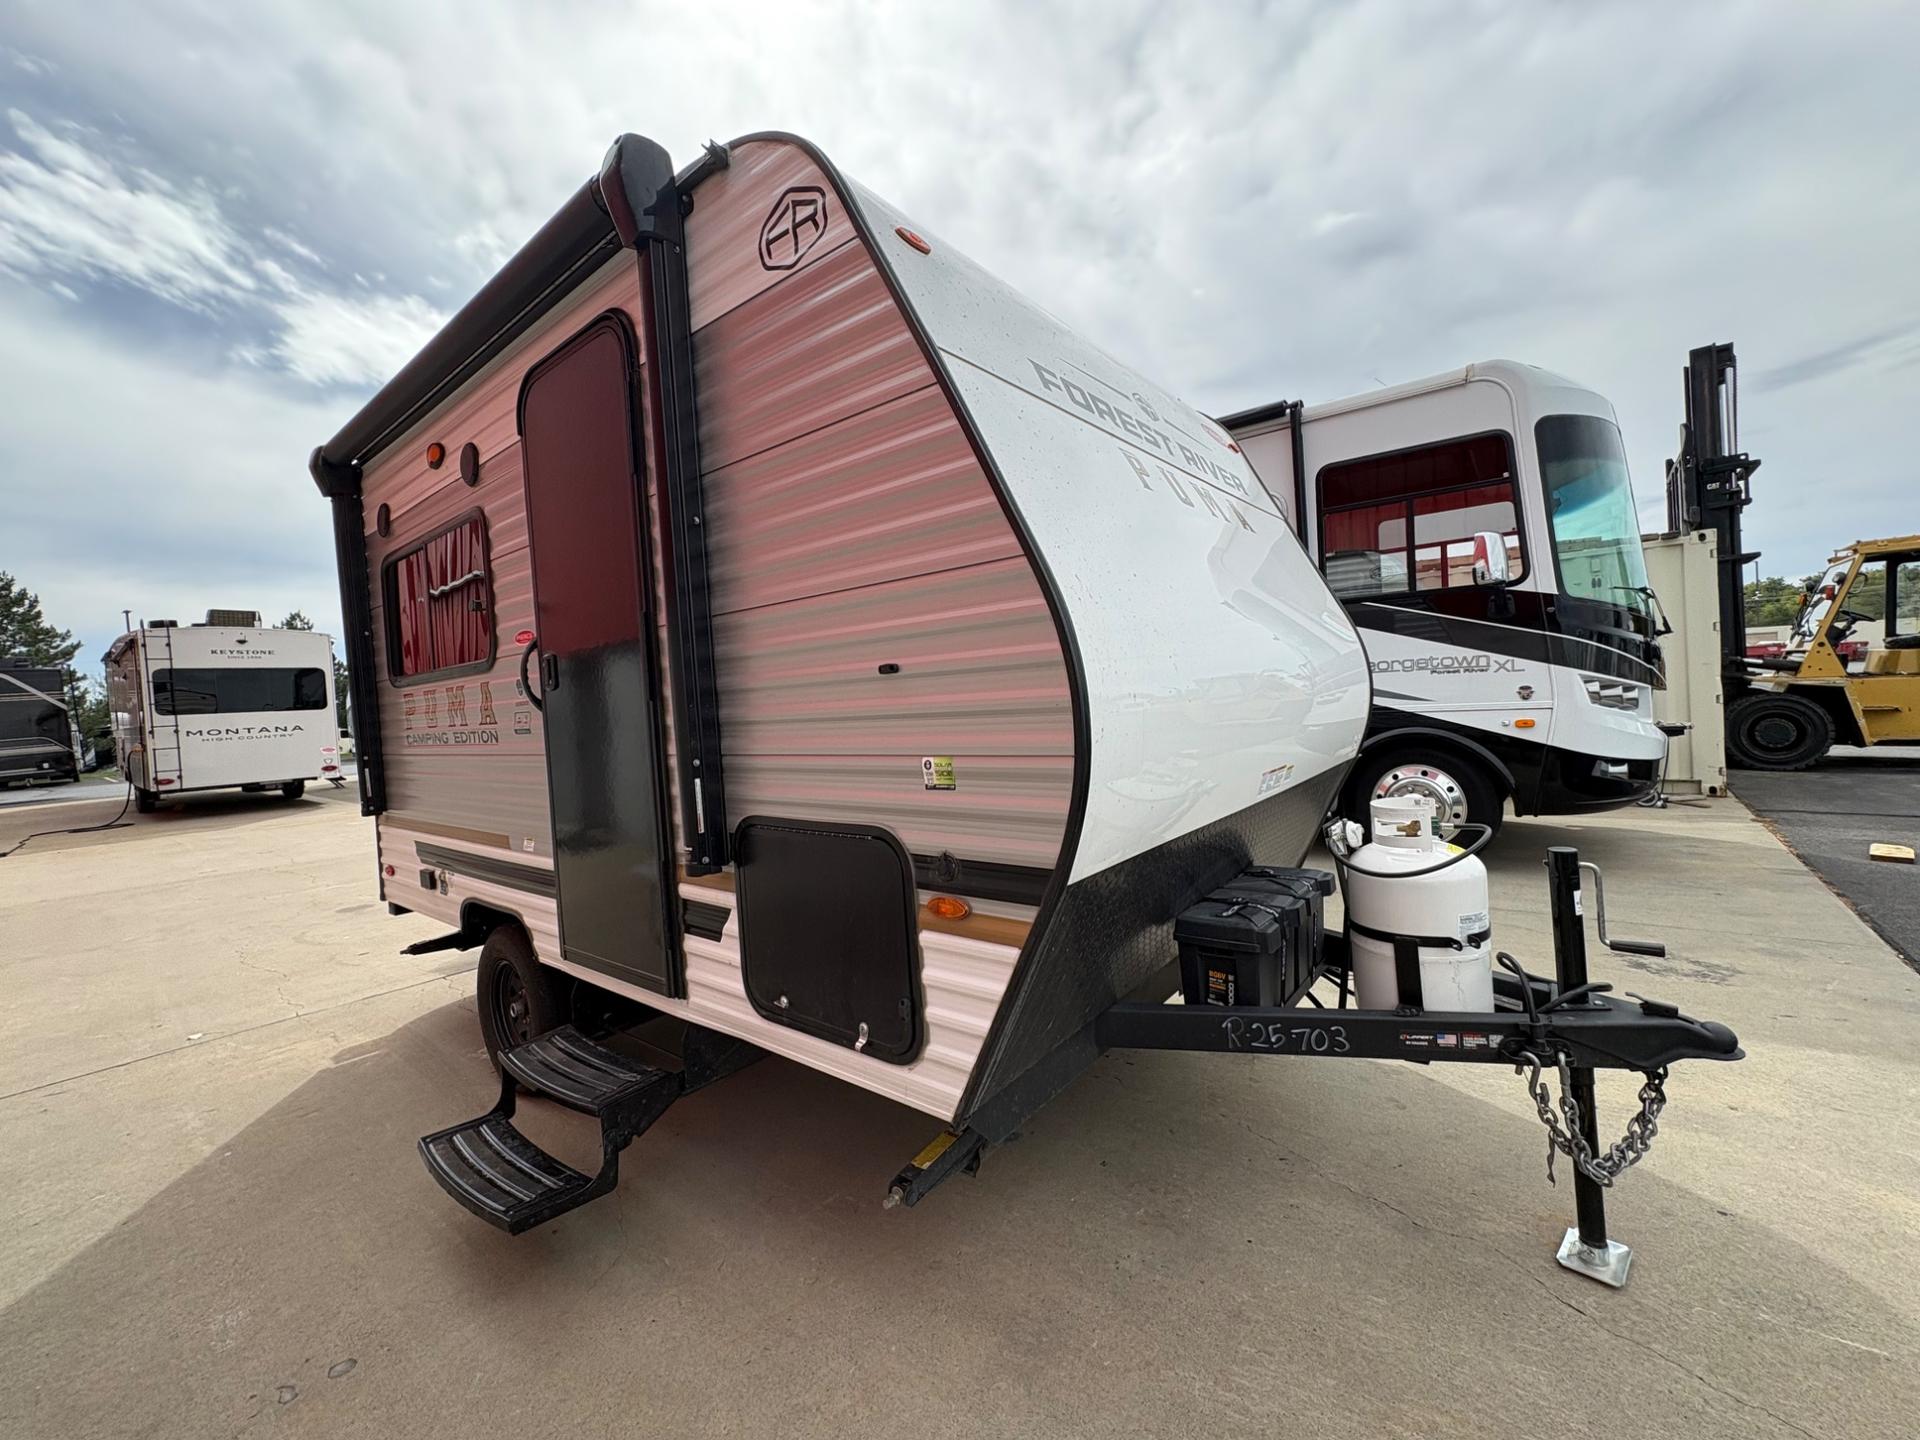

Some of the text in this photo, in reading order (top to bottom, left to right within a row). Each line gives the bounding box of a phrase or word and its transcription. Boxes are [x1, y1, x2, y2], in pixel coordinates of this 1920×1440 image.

[1026, 356, 1249, 496] FOREST RIVER
[1118, 446, 1257, 534] PUMA
[1493, 658, 1526, 673] XL
[403, 681, 498, 730] PUMA
[185, 725, 304, 737] MONTANA
[238, 733, 294, 741] COUNTRY
[406, 732, 449, 745] CAMPING
[452, 730, 499, 744] EDITION
